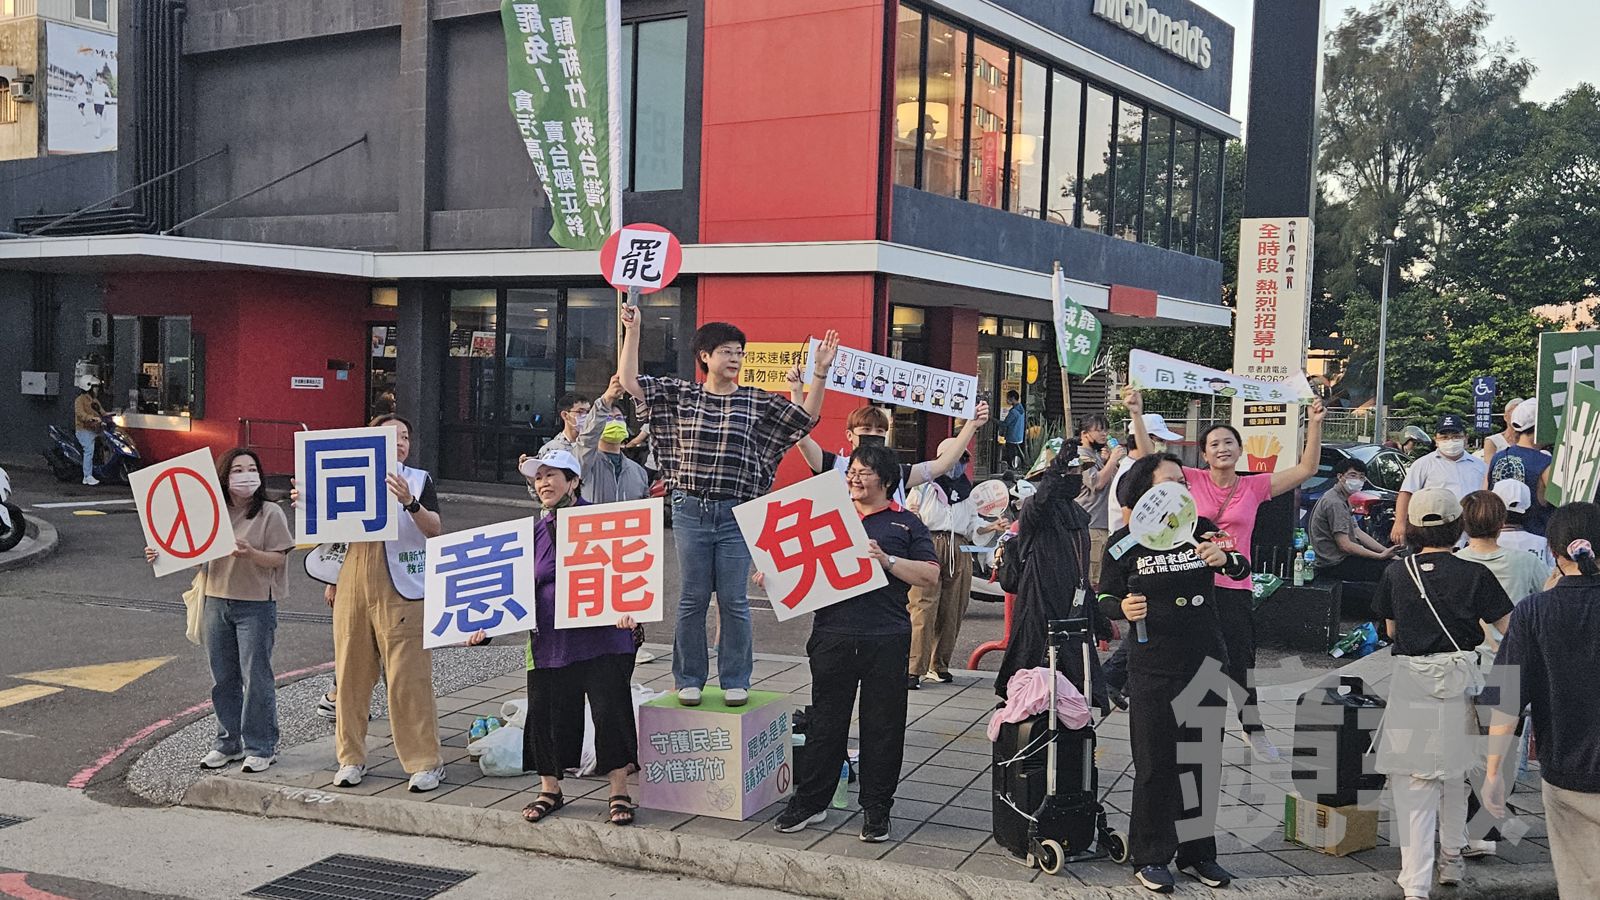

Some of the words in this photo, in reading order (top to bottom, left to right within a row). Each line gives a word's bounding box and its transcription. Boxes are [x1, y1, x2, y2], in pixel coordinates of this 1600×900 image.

[1093, 0, 1211, 69] McDonald's
[621, 238, 662, 282] 罷
[1256, 223, 1281, 274] 全時段
[1252, 279, 1279, 364] 熱烈招募中
[304, 435, 388, 535] 同
[563, 508, 655, 619] 罷
[755, 497, 874, 610] 免
[1136, 548, 1201, 569] 自己國家自己
[1157, 564, 1168, 573] THE
[1170, 560, 1207, 571] GOVERNMEN
[431, 530, 528, 637] 意
[650, 727, 733, 755] 守護民主
[747, 712, 788, 762] 罷免是愛
[644, 756, 725, 784] 珍惜新竹
[744, 743, 786, 796] 請投同意
